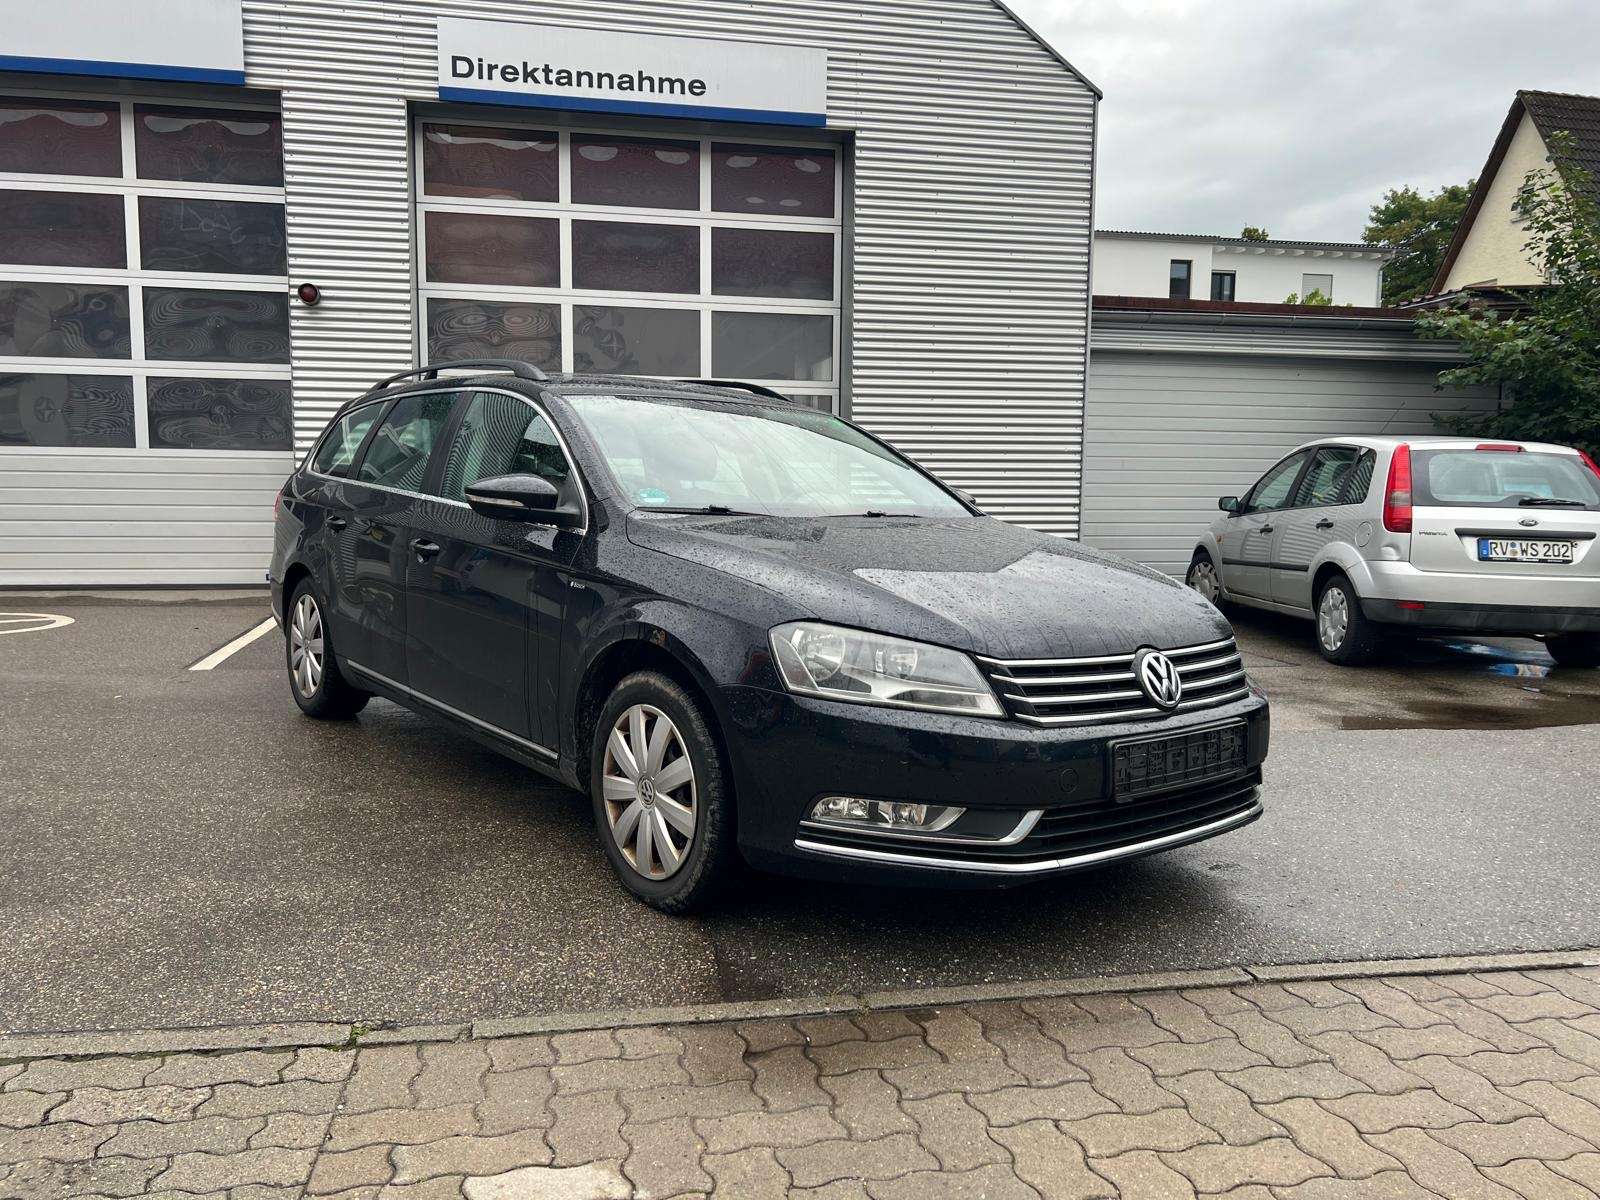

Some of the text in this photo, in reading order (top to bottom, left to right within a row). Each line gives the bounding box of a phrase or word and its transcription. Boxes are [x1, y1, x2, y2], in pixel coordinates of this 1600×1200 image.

[451, 55, 707, 97] Direktannahme
[1490, 541, 1570, 558] RV WS 202
